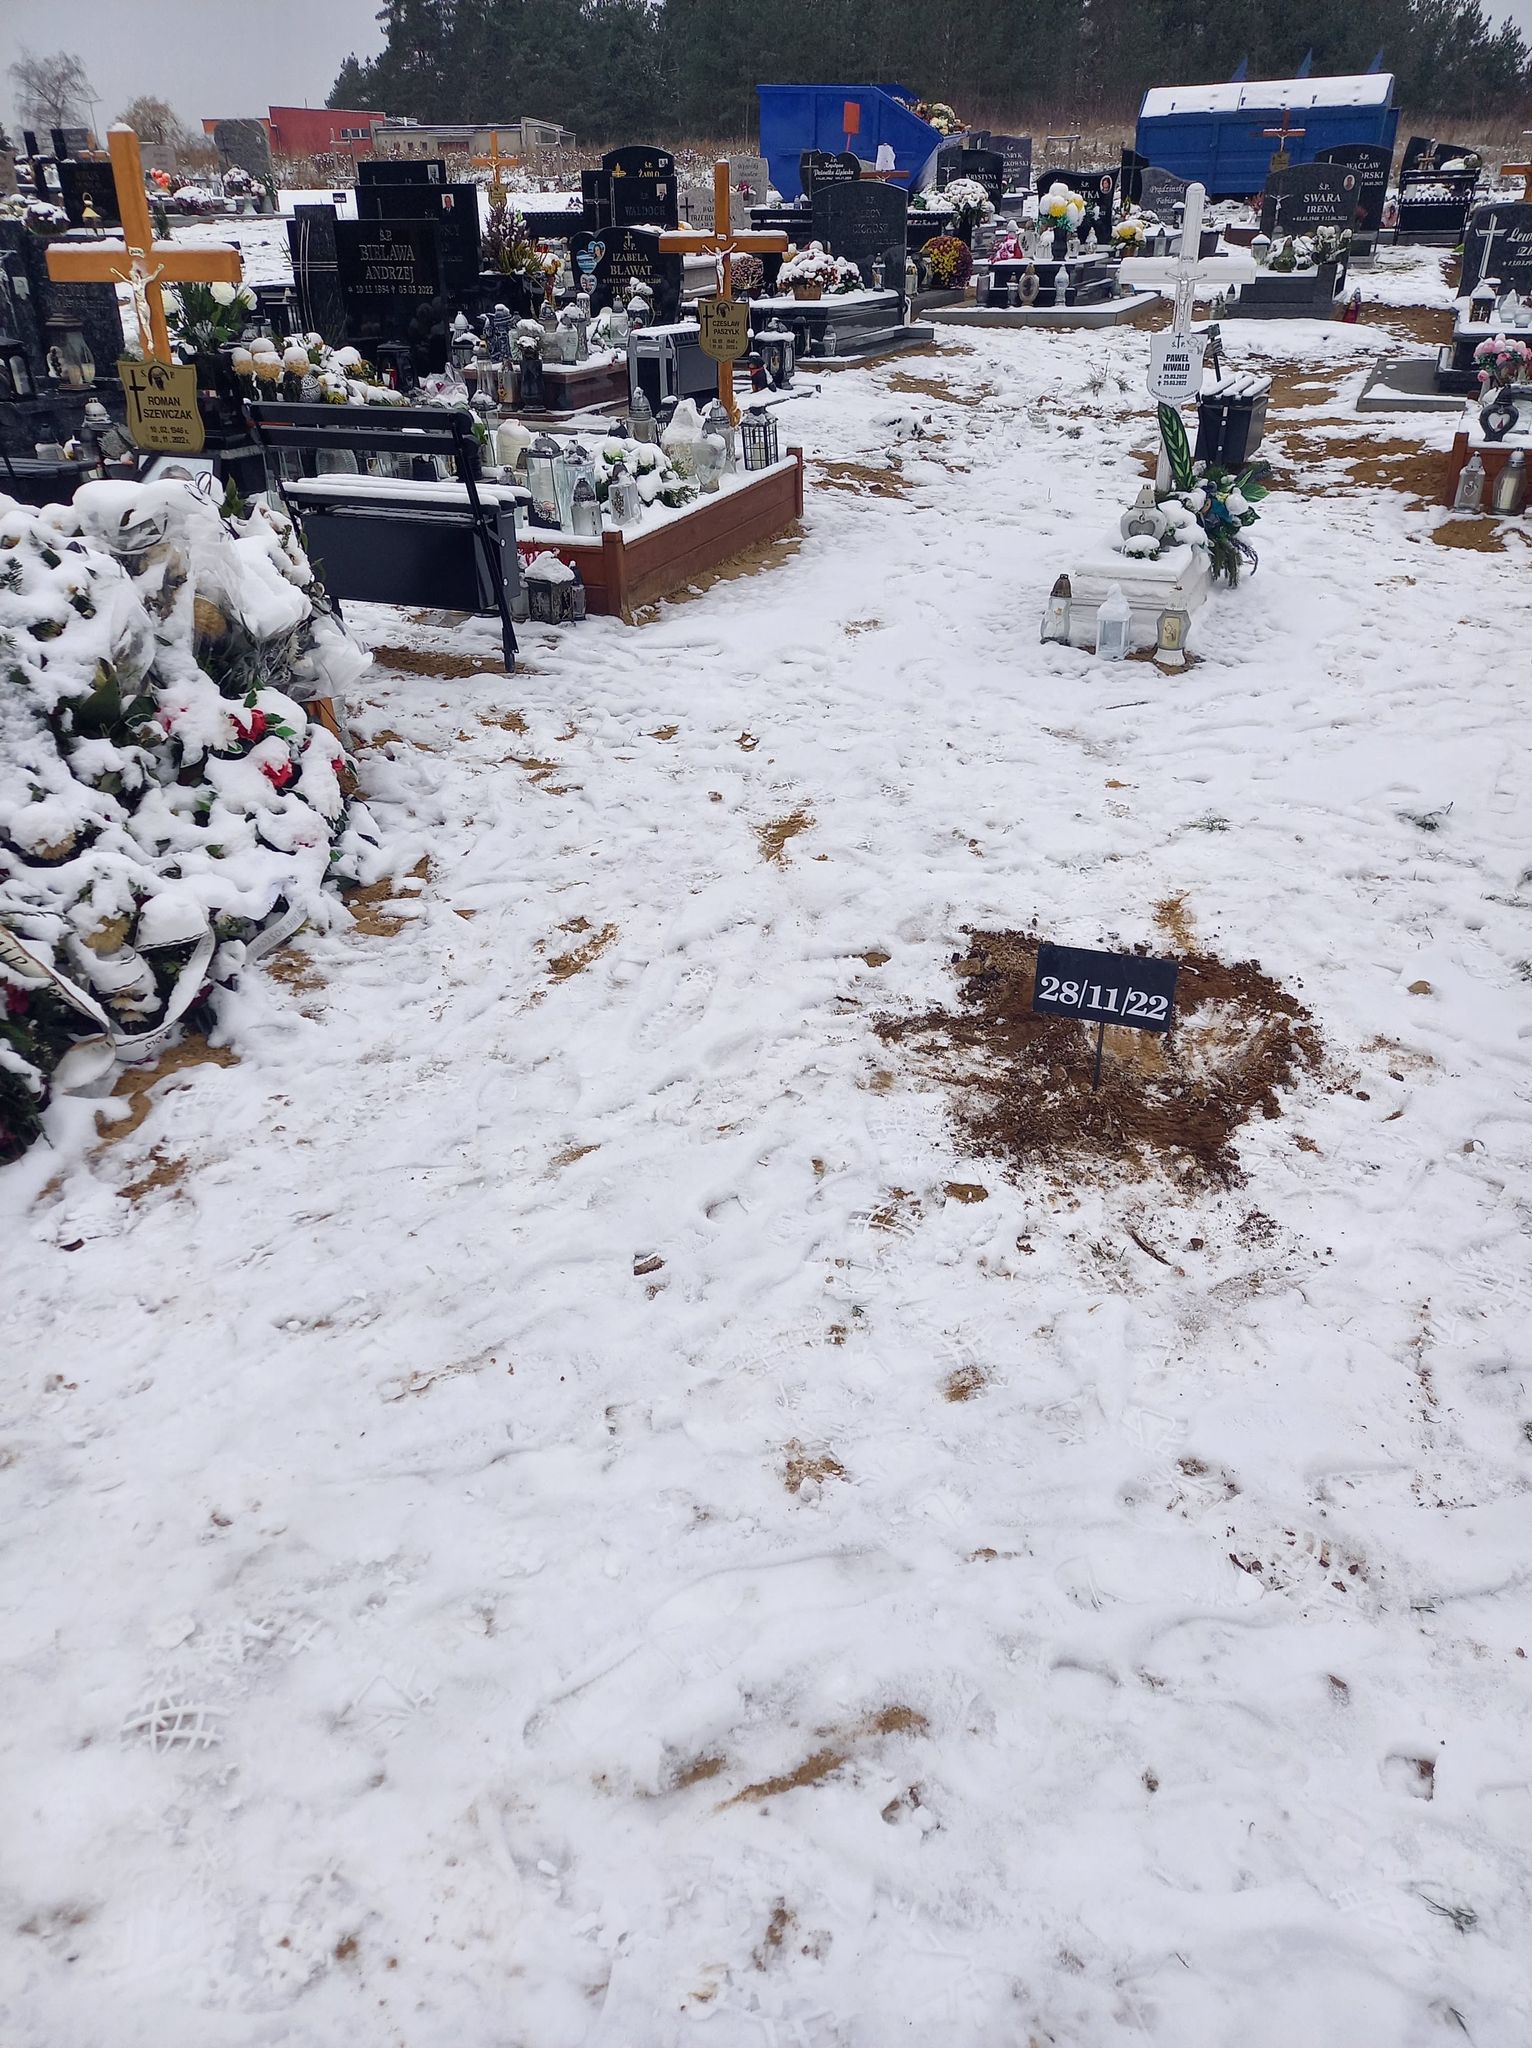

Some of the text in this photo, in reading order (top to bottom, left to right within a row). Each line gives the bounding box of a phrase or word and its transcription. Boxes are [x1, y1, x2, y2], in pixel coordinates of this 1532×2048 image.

[1303, 193, 1341, 203] SWARA
[1306, 205, 1336, 213] IRENA
[358, 244, 416, 261] BIELAWA
[612, 253, 649, 262] IZABELA
[365, 266, 414, 283] ANDRZEJ
[147, 395, 181, 407] ROMAN
[143, 408, 193, 420] SZEWCZAK
[1038, 976, 1169, 1021] 28/11/22
